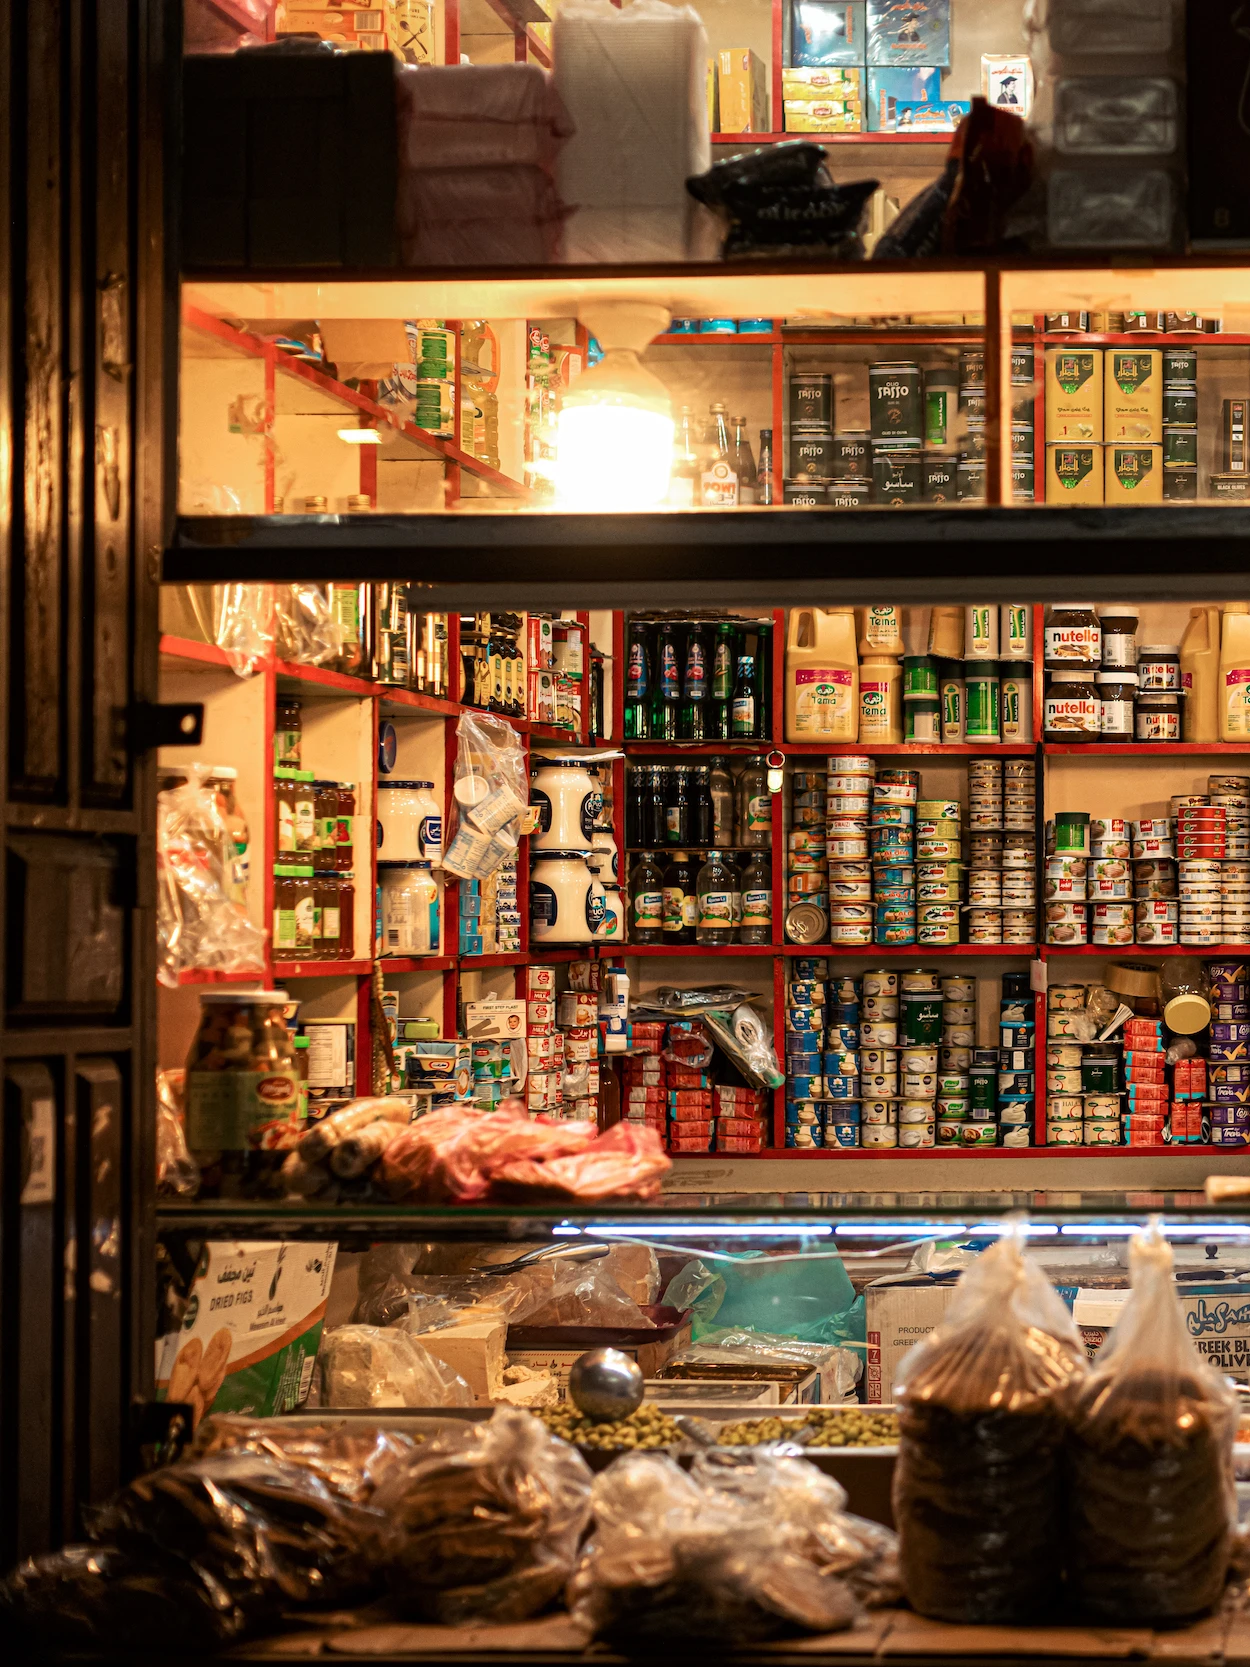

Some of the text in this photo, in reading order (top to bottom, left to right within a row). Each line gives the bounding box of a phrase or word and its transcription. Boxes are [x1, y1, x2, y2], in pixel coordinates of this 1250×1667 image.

[878, 386, 909, 399] SASSO
[869, 616, 897, 627] Tema
[1053, 628, 1099, 643] nutella
[811, 695, 837, 705] Tema
[1048, 699, 1096, 715] nutella
[860, 708, 887, 721] Tema
[1216, 1085, 1234, 1096] Treva
[1223, 1127, 1241, 1138] Treva
[209, 1289, 254, 1312] DRIED FIGS
[898, 1326, 936, 1335] PRODUCT
